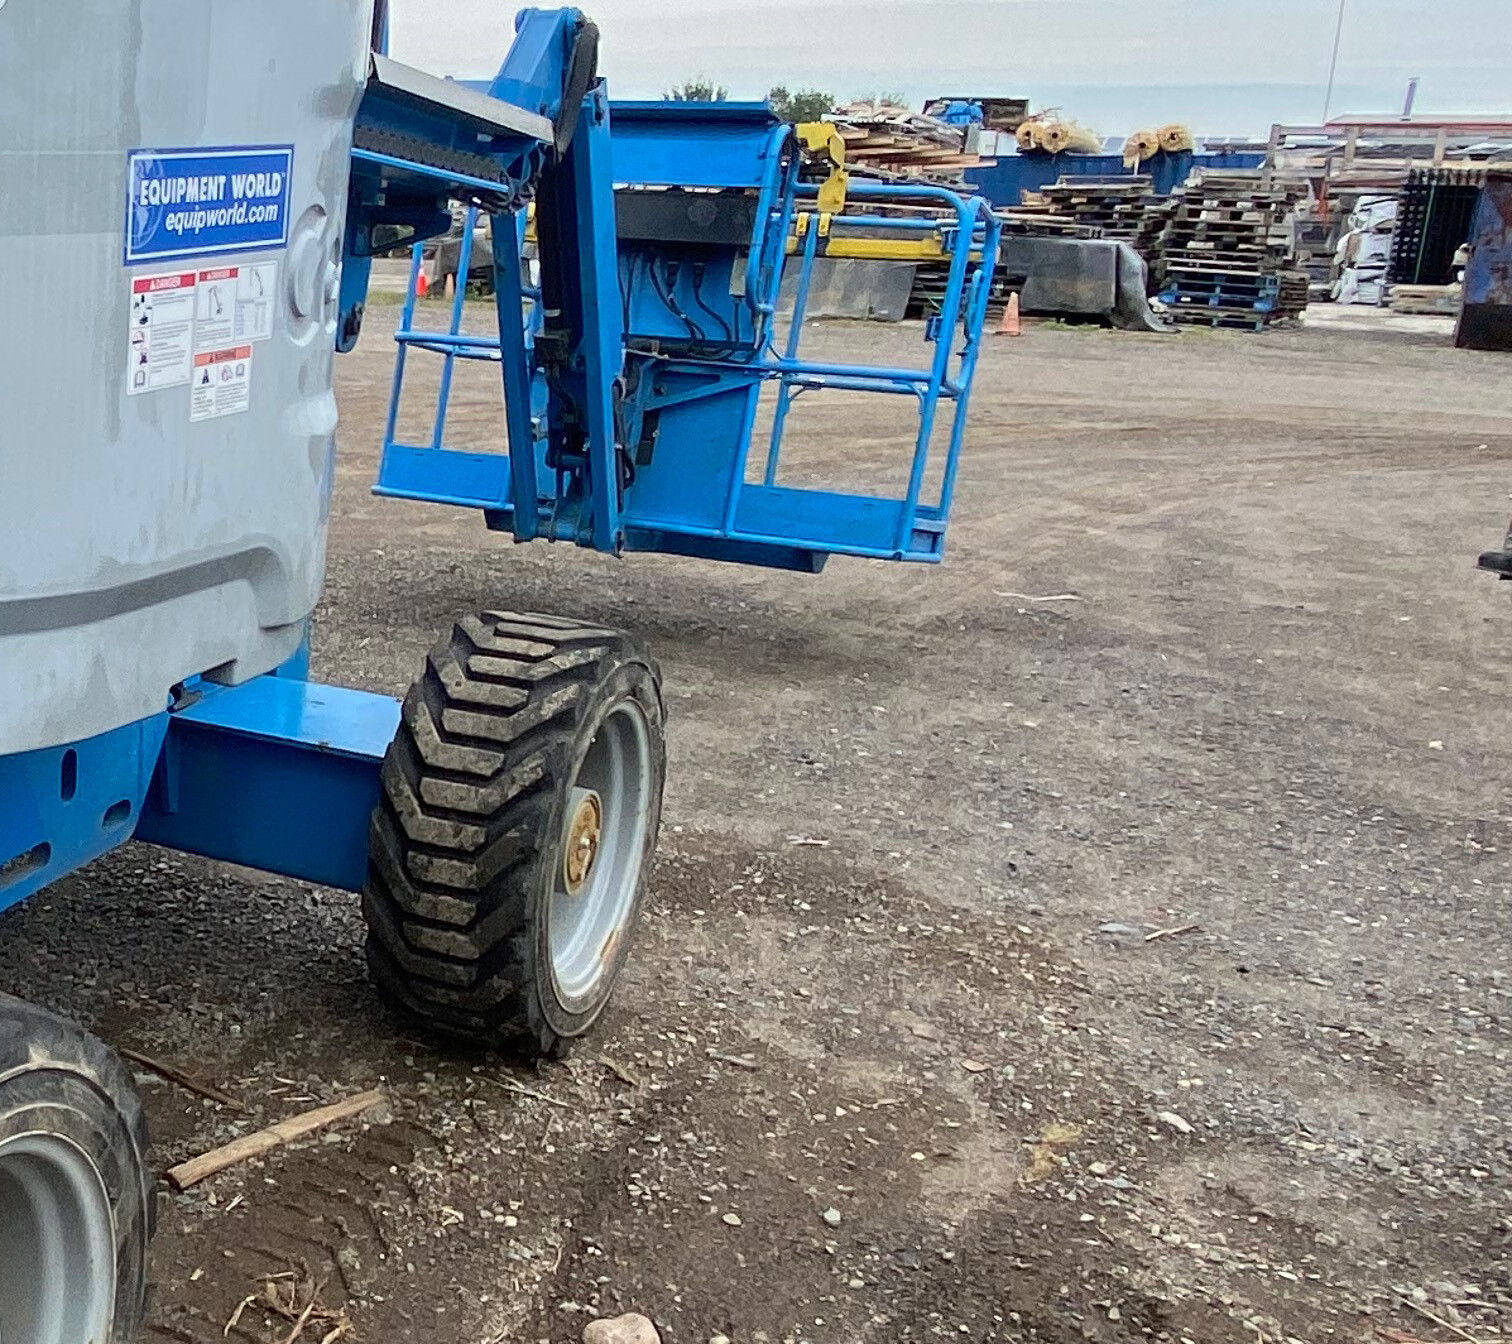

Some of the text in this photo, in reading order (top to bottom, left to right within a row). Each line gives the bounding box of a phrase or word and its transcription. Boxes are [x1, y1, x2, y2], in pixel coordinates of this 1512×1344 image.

[139, 172, 281, 206] EQUIPMENT WORLD
[165, 203, 278, 234] equipworld.com
